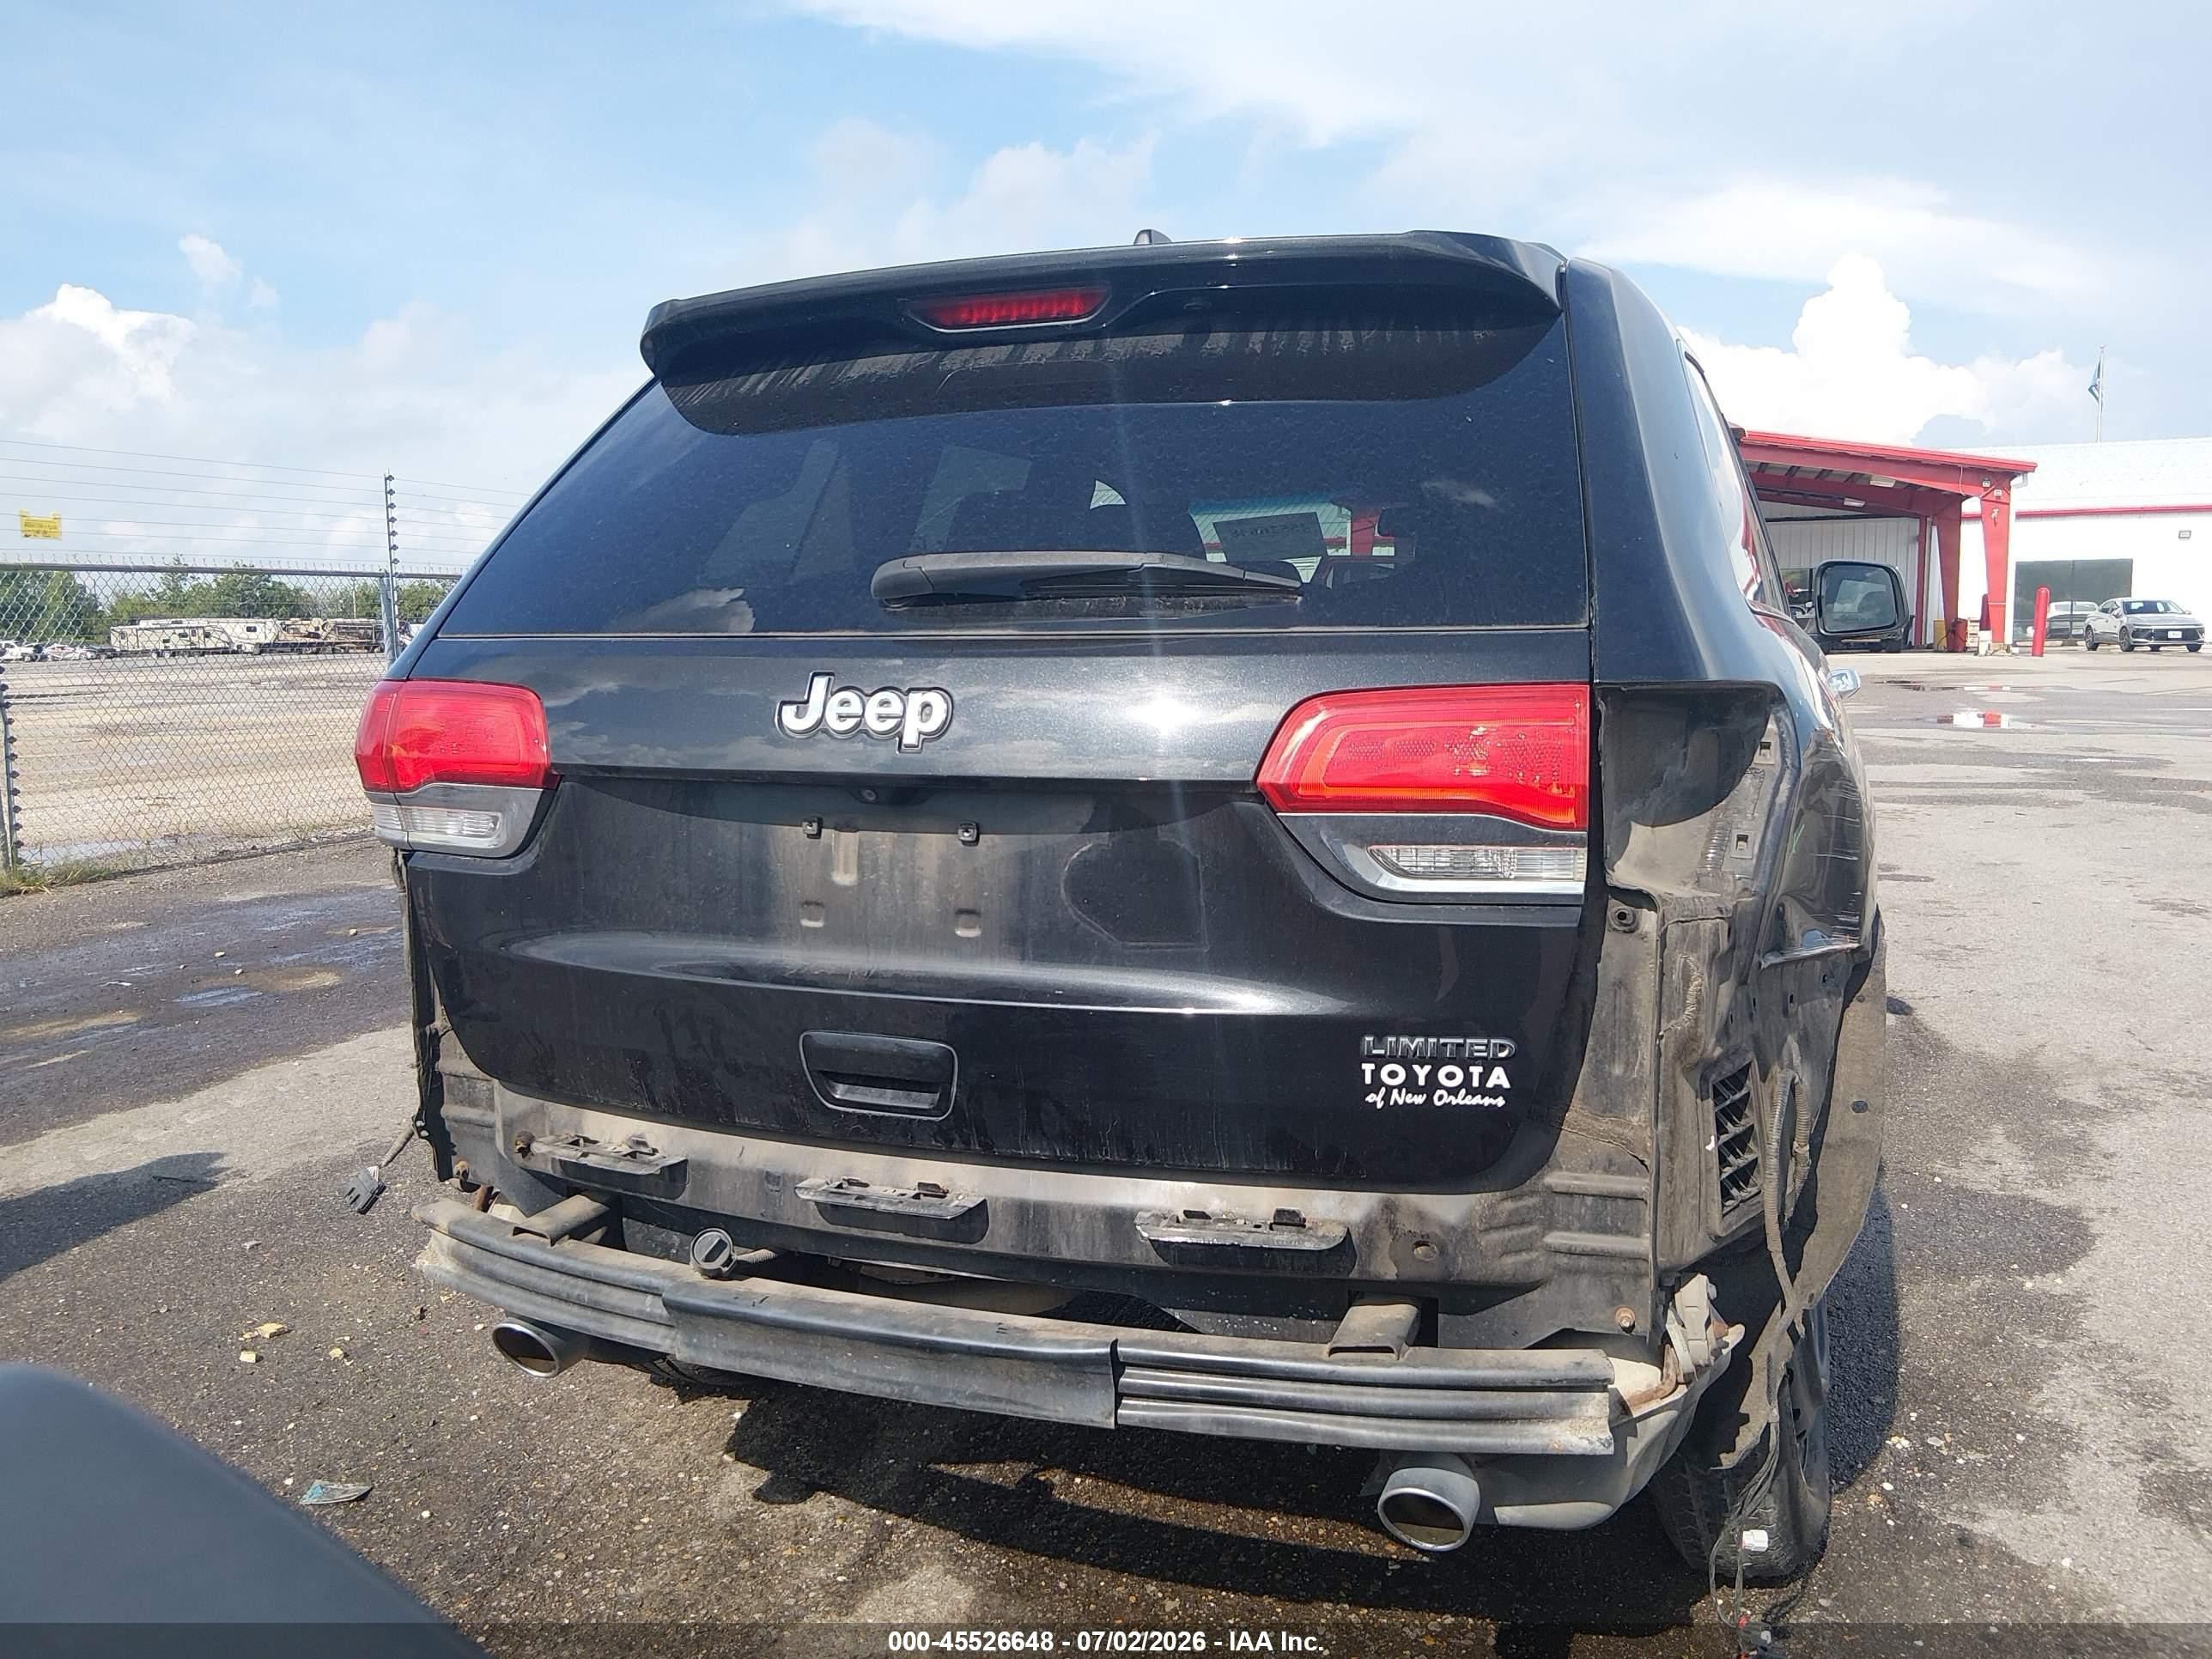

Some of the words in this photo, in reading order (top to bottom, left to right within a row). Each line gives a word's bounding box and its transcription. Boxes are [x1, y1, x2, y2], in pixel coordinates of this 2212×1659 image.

[777, 672, 952, 751] Jeep
[1363, 1036, 1516, 1058] LIMITED
[1361, 1062, 1511, 1089] TOYOTA
[1365, 1086, 1386, 1109] of
[1389, 1088, 1427, 1106] New
[1433, 1089, 1506, 1108] Orleans
